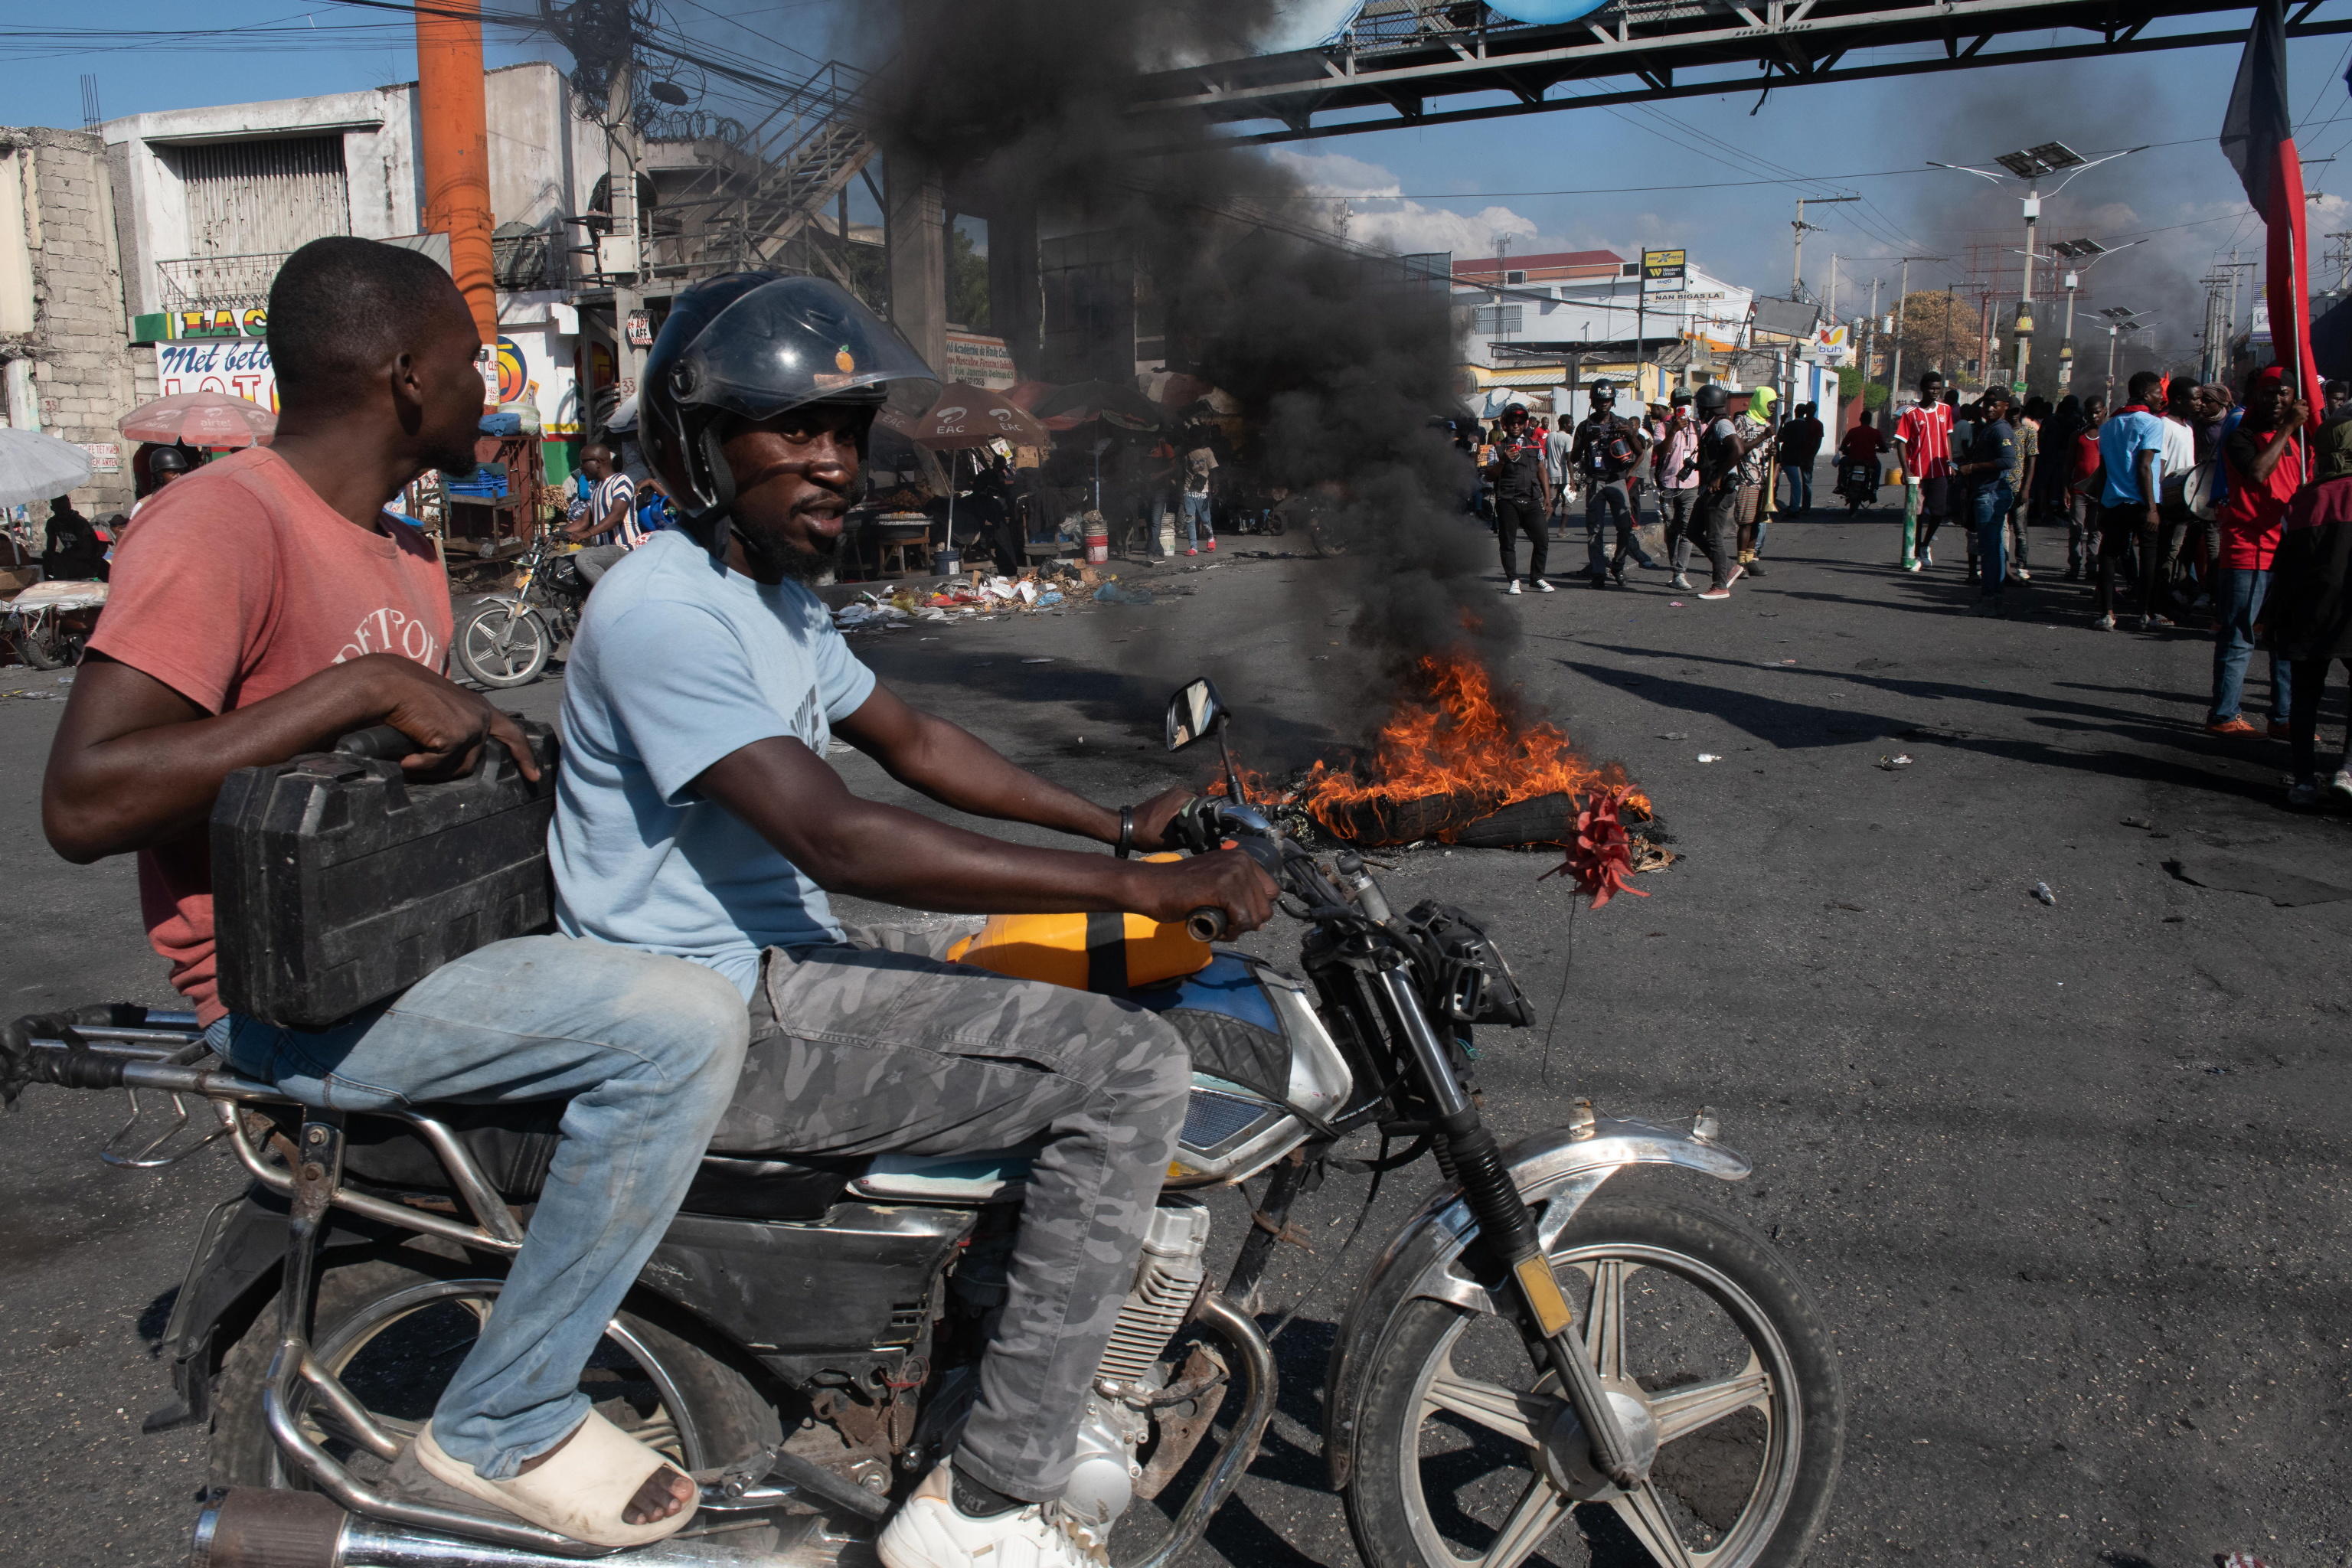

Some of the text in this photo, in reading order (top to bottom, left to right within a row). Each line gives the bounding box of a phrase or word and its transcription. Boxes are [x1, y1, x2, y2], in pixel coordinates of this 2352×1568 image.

[635, 328, 648, 338] AFF
[162, 342, 220, 374] Mèt
[954, 367, 965, 375] Rue
[967, 369, 988, 377] Jasmin
[622, 380, 636, 394] 33
[201, 419, 233, 429] airtel
[881, 415, 905, 428] EAC
[936, 426, 965, 434] EAC
[999, 423, 1024, 431] EAC
